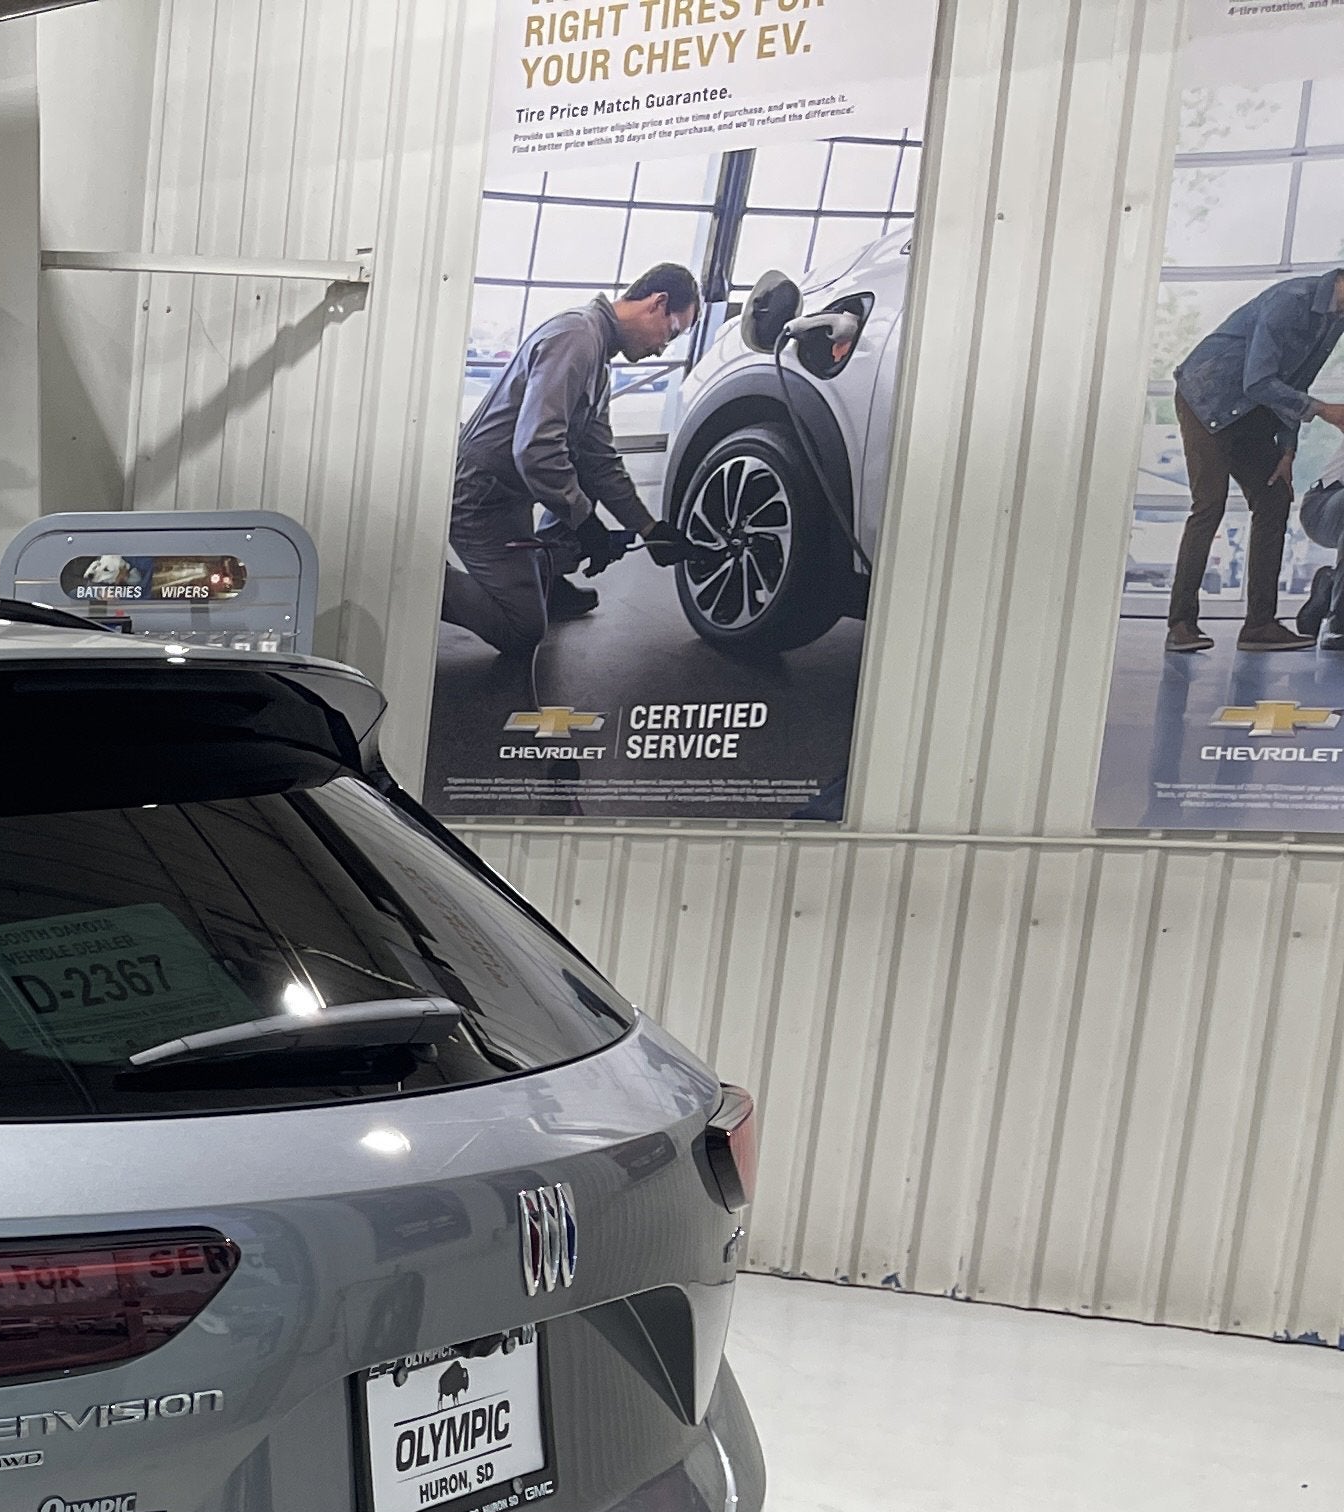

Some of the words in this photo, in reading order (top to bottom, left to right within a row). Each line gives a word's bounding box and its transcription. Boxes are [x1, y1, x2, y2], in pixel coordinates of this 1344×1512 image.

[524, 4, 628, 48] RIGHT
[640, 0, 741, 32] TIRES
[521, 49, 610, 89] YOUR
[623, 28, 746, 77] CHEVY
[756, 20, 812, 60] EV.
[513, 131, 543, 142] Provide
[545, 131, 554, 140] us
[557, 128, 574, 138] with
[583, 124, 609, 136] better
[610, 121, 640, 134] eligible
[641, 118, 663, 130] price
[665, 117, 674, 126] at
[676, 115, 690, 124] the
[692, 112, 710, 122] time
[712, 110, 721, 120] of
[723, 106, 765, 120] purchase,
[768, 102, 784, 112] and
[808, 95, 836, 107] match
[515, 107, 545, 123] Tire
[549, 103, 589, 120] Price
[593, 95, 640, 115] Match
[645, 86, 733, 109] Guarantee.
[512, 144, 529, 154] Find
[538, 141, 562, 152] better
[564, 138, 585, 151] price
[587, 135, 613, 146] within
[626, 131, 646, 143] days
[647, 129, 656, 140] of
[658, 127, 672, 138] the
[674, 123, 716, 139] purchase,
[717, 121, 733, 132] and
[757, 113, 786, 126] refund
[788, 111, 803, 121] the
[76, 586, 143, 599] BATTERIES
[161, 585, 210, 599] WIPERS
[629, 702, 769, 731] CERTIFIED
[499, 746, 607, 760] CHEVROLET
[625, 734, 740, 759] SERVICE
[1200, 745, 1344, 762] CHEVROLET
[1, 944, 75, 966] VEHICLE
[11, 954, 172, 1014] D-2367
[395, 1399, 511, 1473] OLYMPIC
[419, 1469, 472, 1505] HURON,
[476, 1461, 495, 1485] SD
[524, 1480, 554, 1501] GMC
